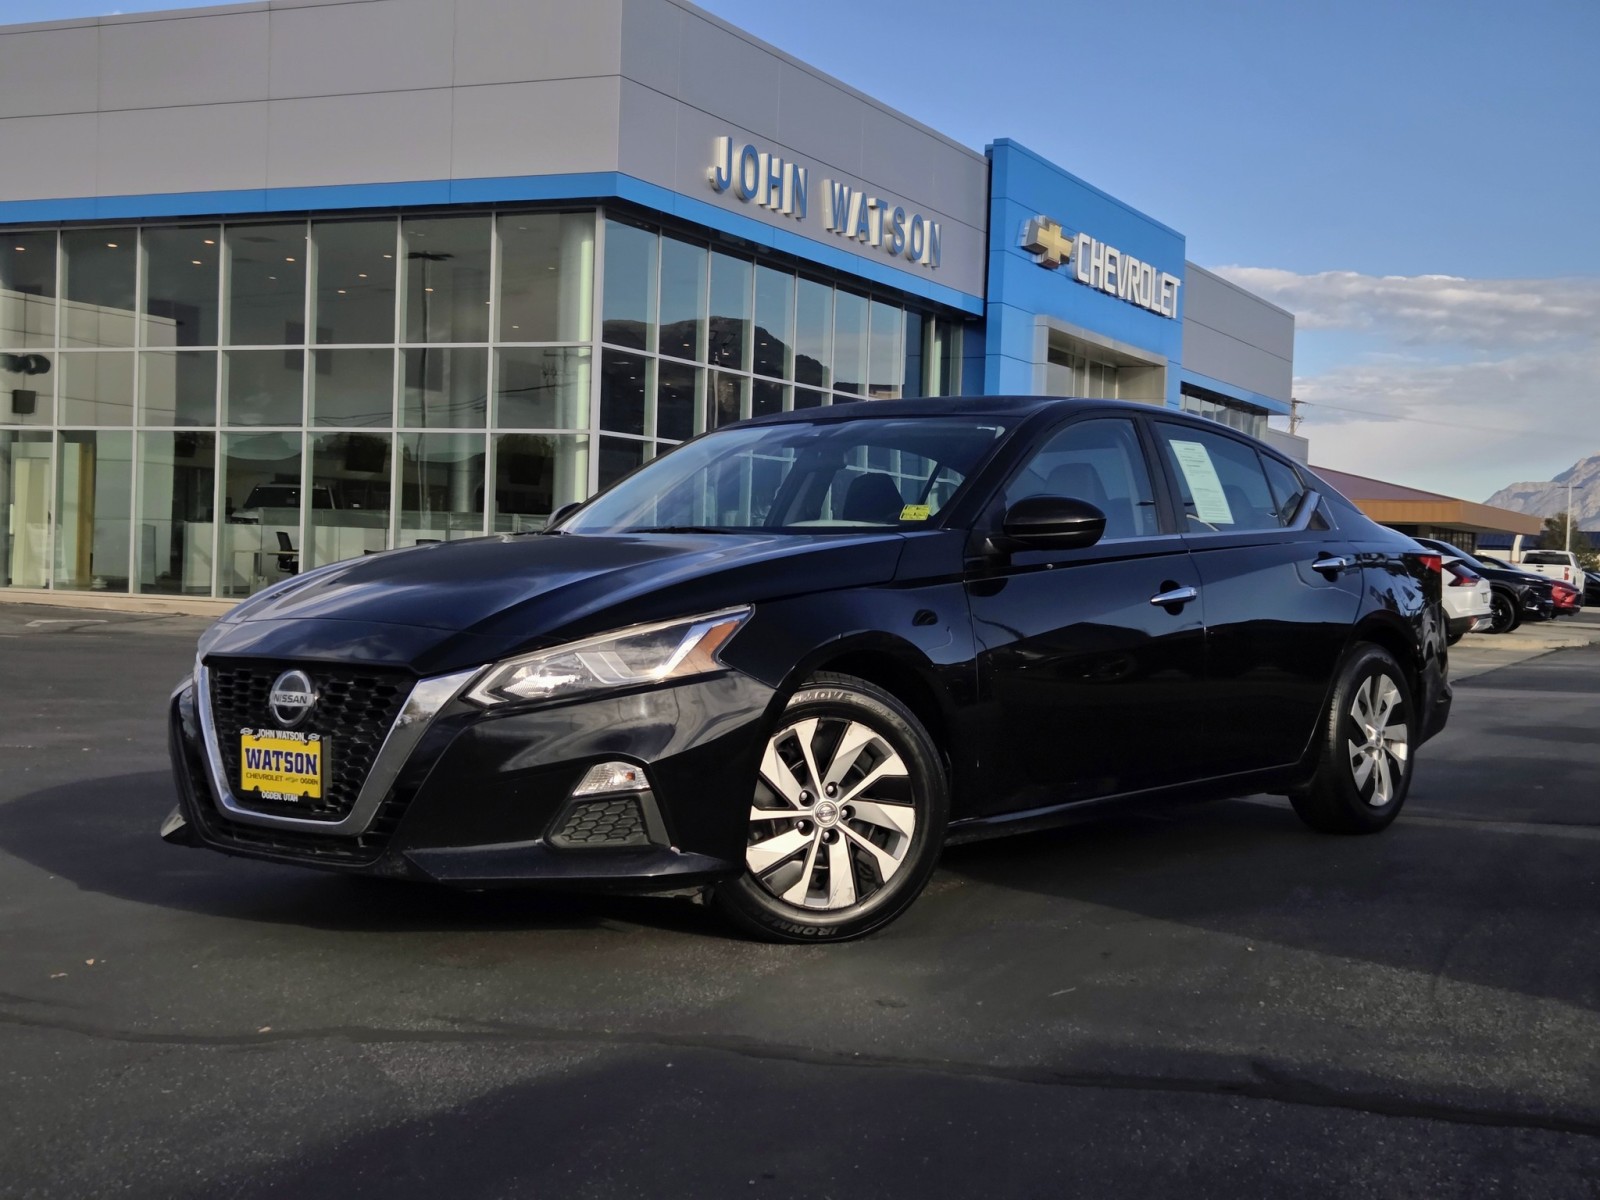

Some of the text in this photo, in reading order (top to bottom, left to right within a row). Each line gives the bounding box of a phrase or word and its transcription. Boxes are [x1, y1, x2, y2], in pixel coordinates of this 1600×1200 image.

[708, 136, 942, 269] JOHN WATSON
[1073, 232, 1181, 319] CHEVROLET
[273, 693, 308, 704] NISSAN
[257, 728, 305, 742] JOHN WATSON
[245, 748, 318, 776] WATSON
[245, 771, 319, 786] CHEVROLET OGDEN
[283, 793, 299, 803] UTAH
